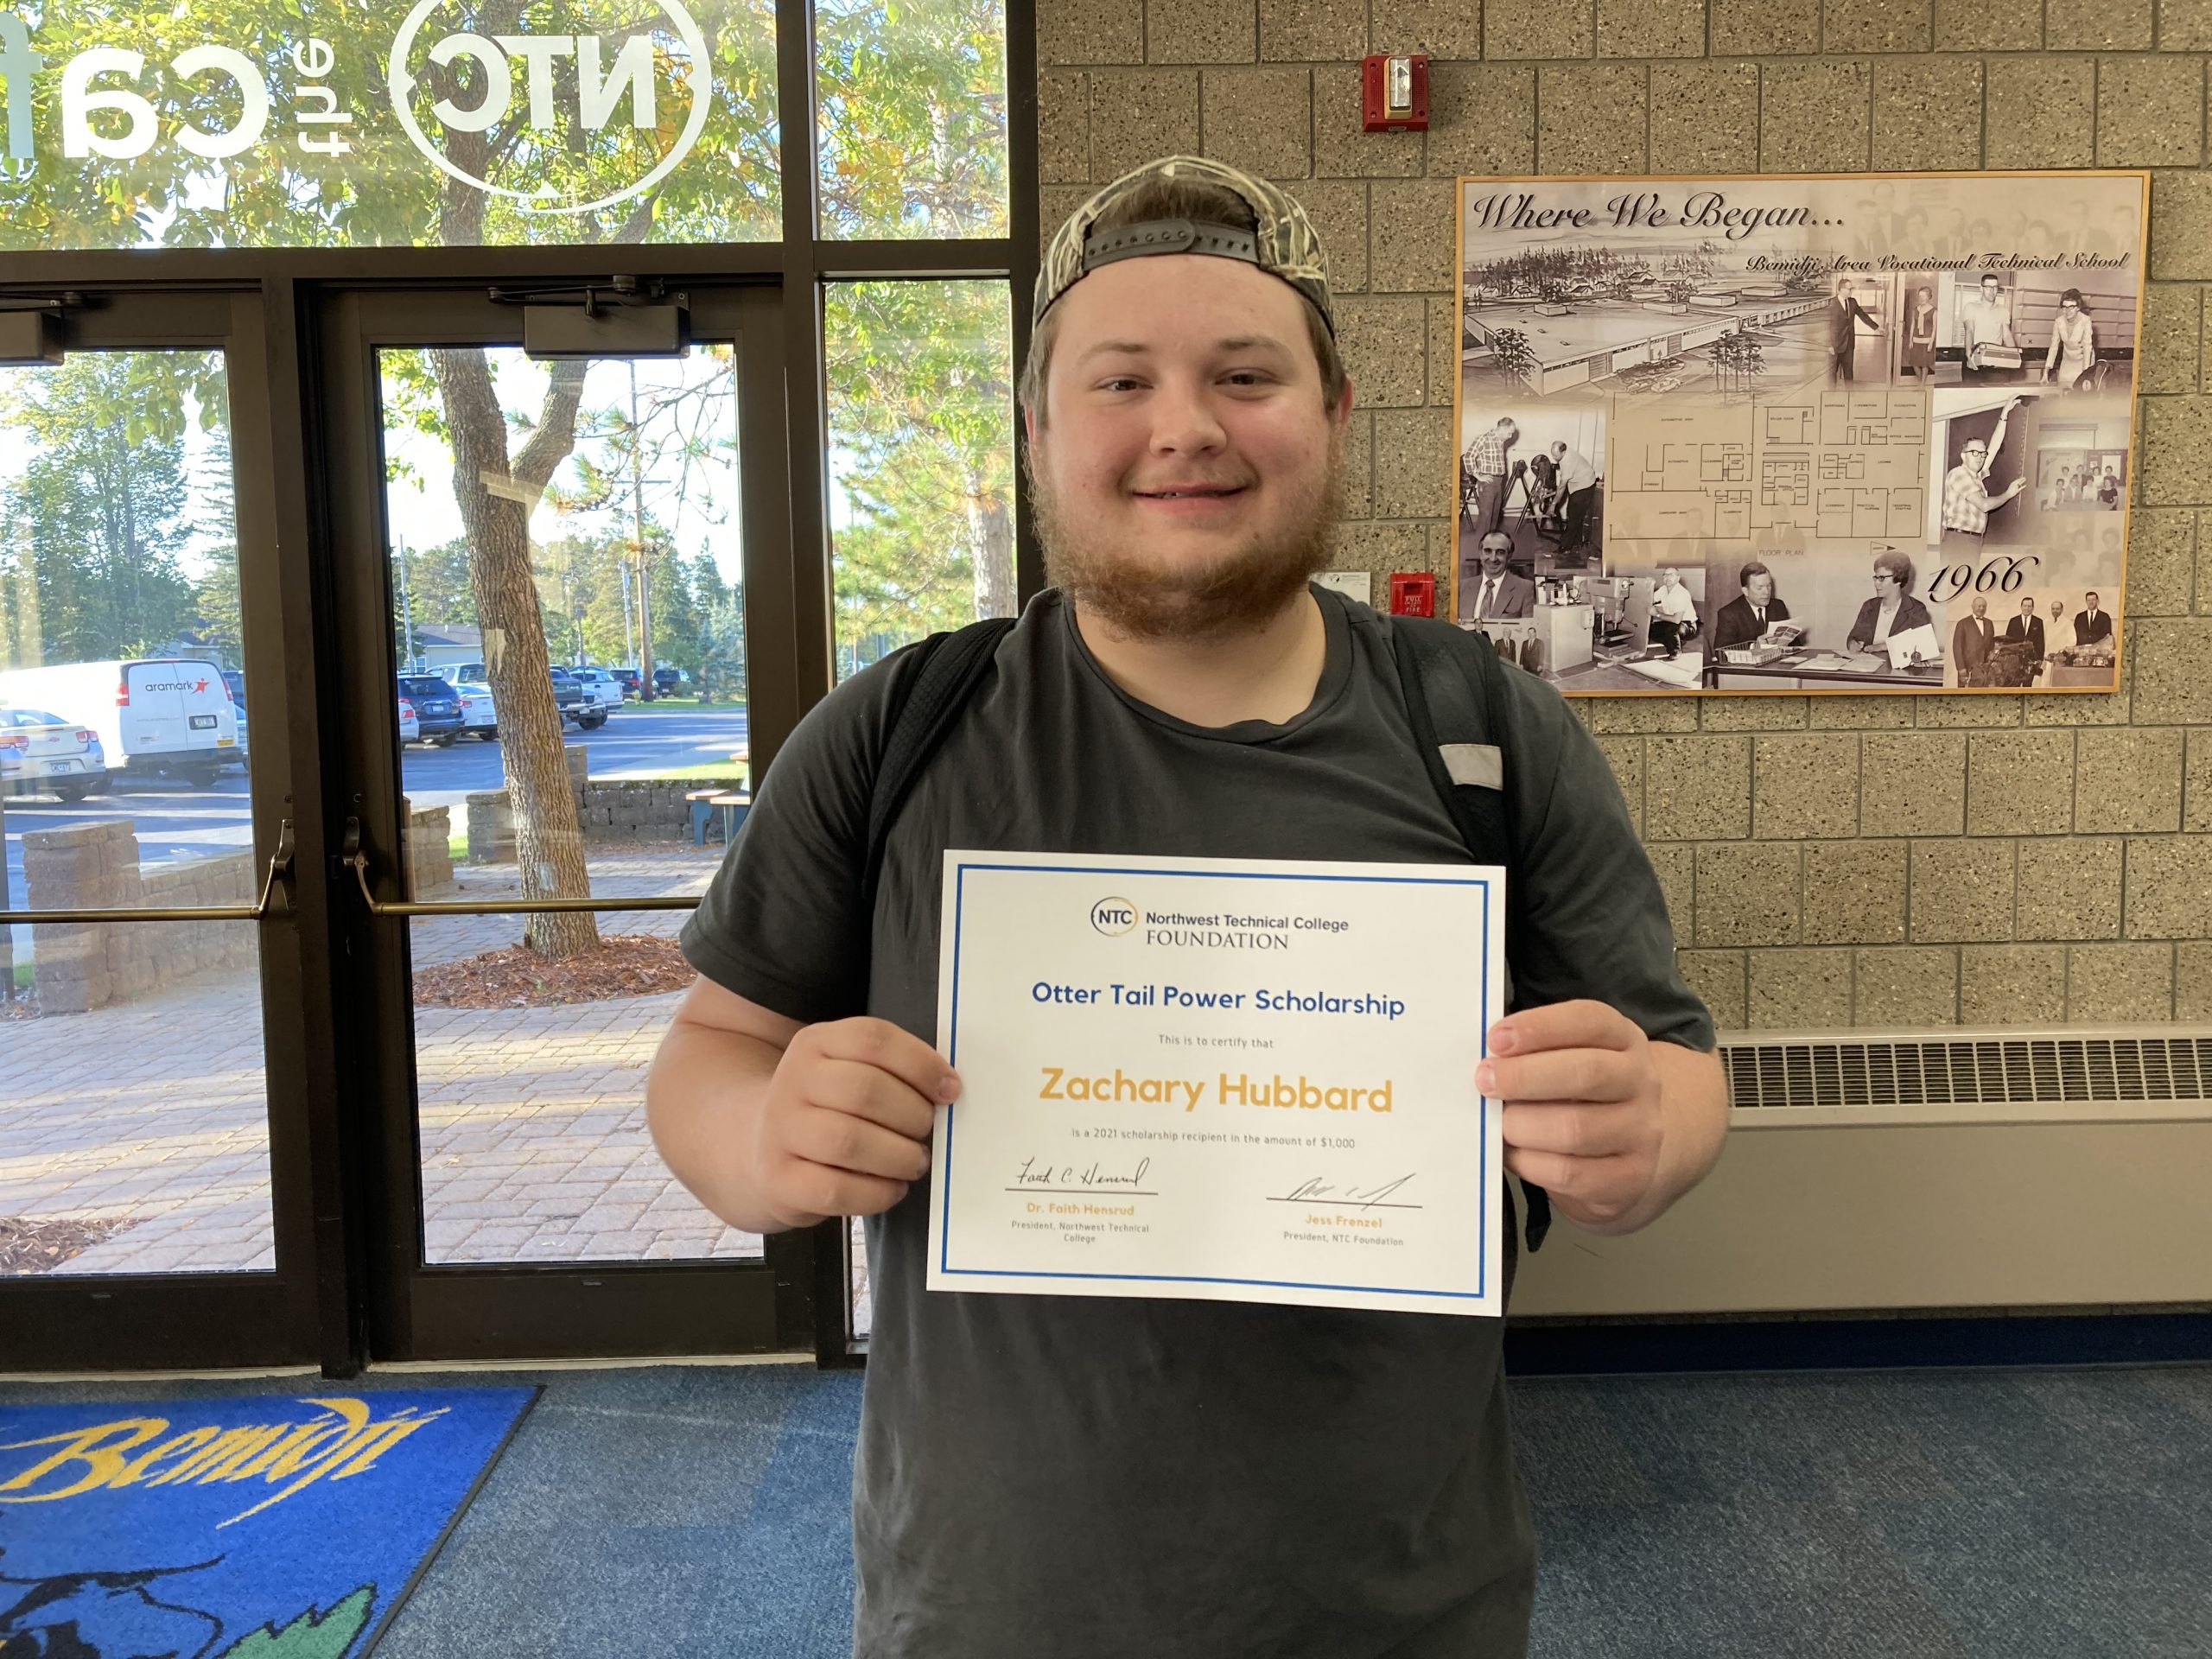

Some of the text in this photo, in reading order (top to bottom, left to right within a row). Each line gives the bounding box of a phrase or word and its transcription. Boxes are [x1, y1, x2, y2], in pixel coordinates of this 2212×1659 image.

[1473, 190, 1844, 241] Where We Began...
[1745, 251, 2129, 277] Bemidji Area Vocational Technical School
[1927, 555, 2040, 603] 1966
[145, 680, 194, 692] aramark
[1098, 908, 1134, 926] NTC
[1145, 911, 1350, 933] Northwest Technical College
[1147, 930, 1288, 950] FOUNDATION
[1033, 982, 1405, 1020] Otter Tail Power Scholarship
[1159, 1033, 1274, 1050] This is to certify that
[1039, 1068, 1392, 1112] Zachary Hubbard
[1071, 1127, 1356, 1149] is a 2021 scholarship recipient in the amount of $1,000
[1027, 1202, 1135, 1216] Dr. Faith Hensrud
[1011, 1219, 1149, 1233] President, Northwest Technical
[1305, 1214, 1382, 1229] Jess Frenzel
[1064, 1233, 1096, 1245] College
[1283, 1230, 1404, 1246] President, NTC Foundation
